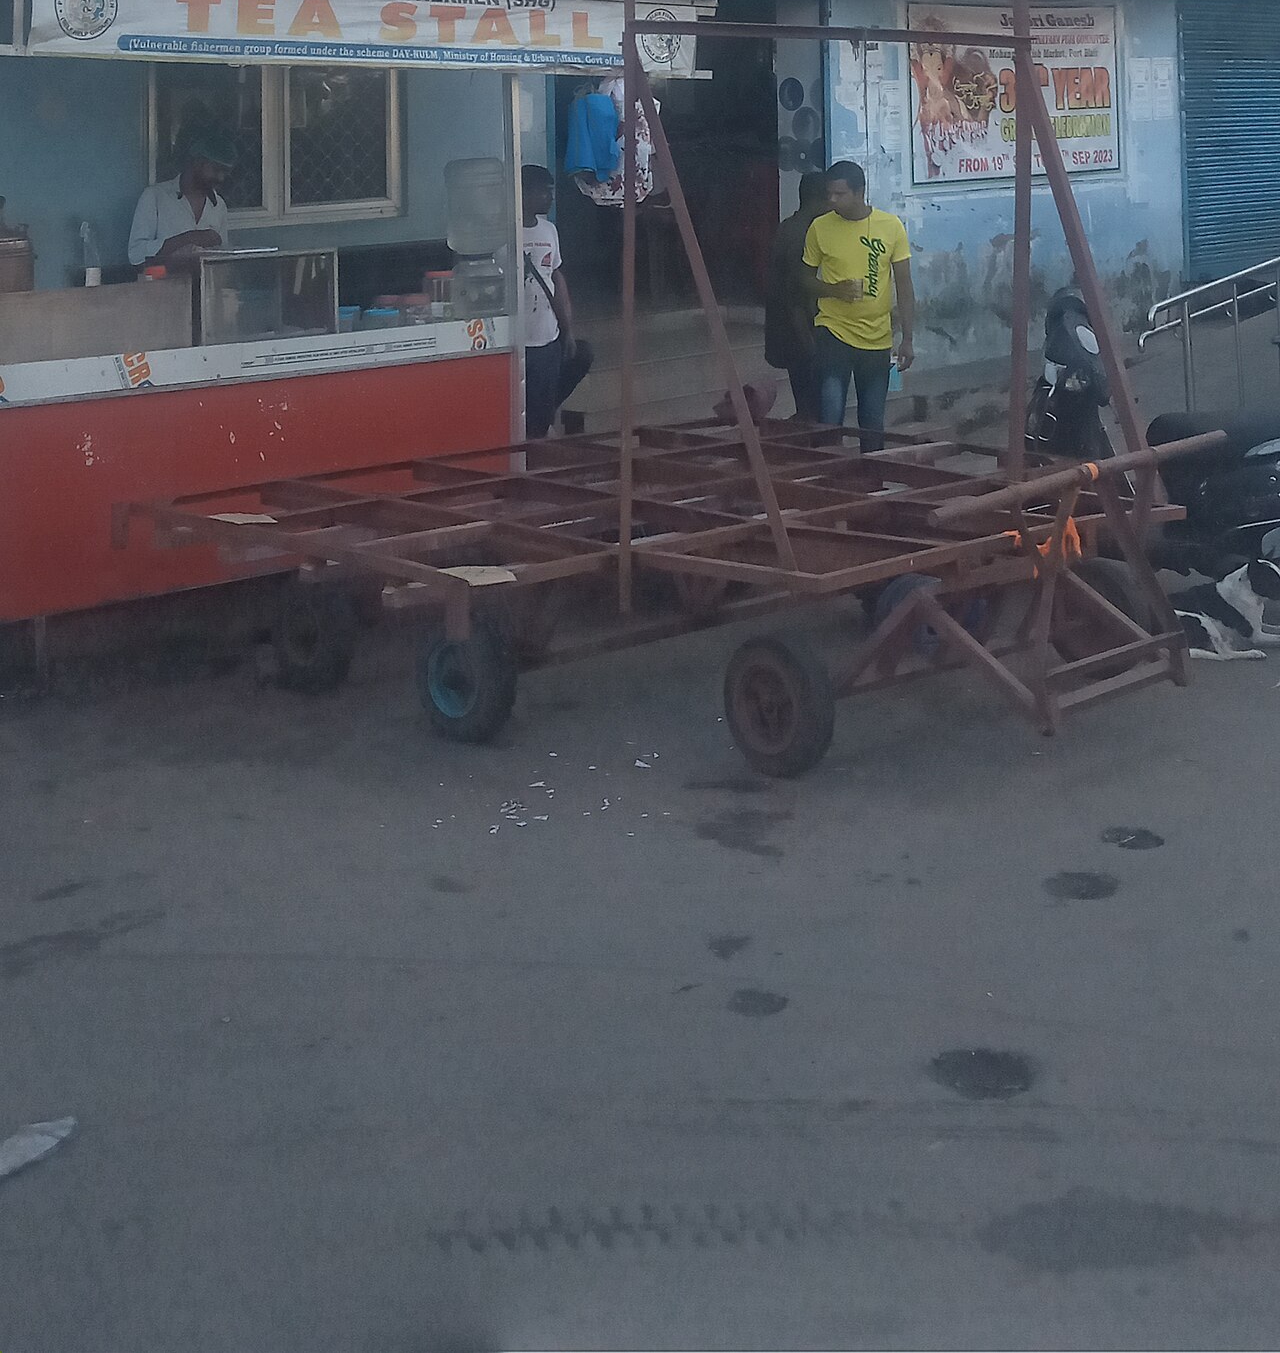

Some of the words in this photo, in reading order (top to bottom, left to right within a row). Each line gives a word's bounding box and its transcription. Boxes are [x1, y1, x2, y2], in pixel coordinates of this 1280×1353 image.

[379, 1, 604, 49] STALL
[1000, 13, 1014, 26] Ja
[1045, 13, 1095, 27] Ganesh
[129, 38, 188, 52] (Vulnerable
[191, 41, 241, 53] fishermen
[243, 44, 272, 55] group
[274, 43, 307, 55] formed
[310, 46, 336, 57] under
[339, 47, 354, 57] the
[356, 48, 390, 58] scheme
[443, 50, 478, 62] Ministry
[481, 52, 488, 61] of
[490, 52, 522, 63] Housing
[523, 54, 530, 62] &
[532, 53, 555, 63] Urban
[585, 55, 603, 65] Govt
[604, 56, 613, 65] of
[1068, 48, 1082, 58] Port
[1050, 67, 1111, 110] YEAR
[958, 157, 989, 174] FROM
[1072, 151, 1091, 165] SEP
[1093, 149, 1113, 165] 2023
